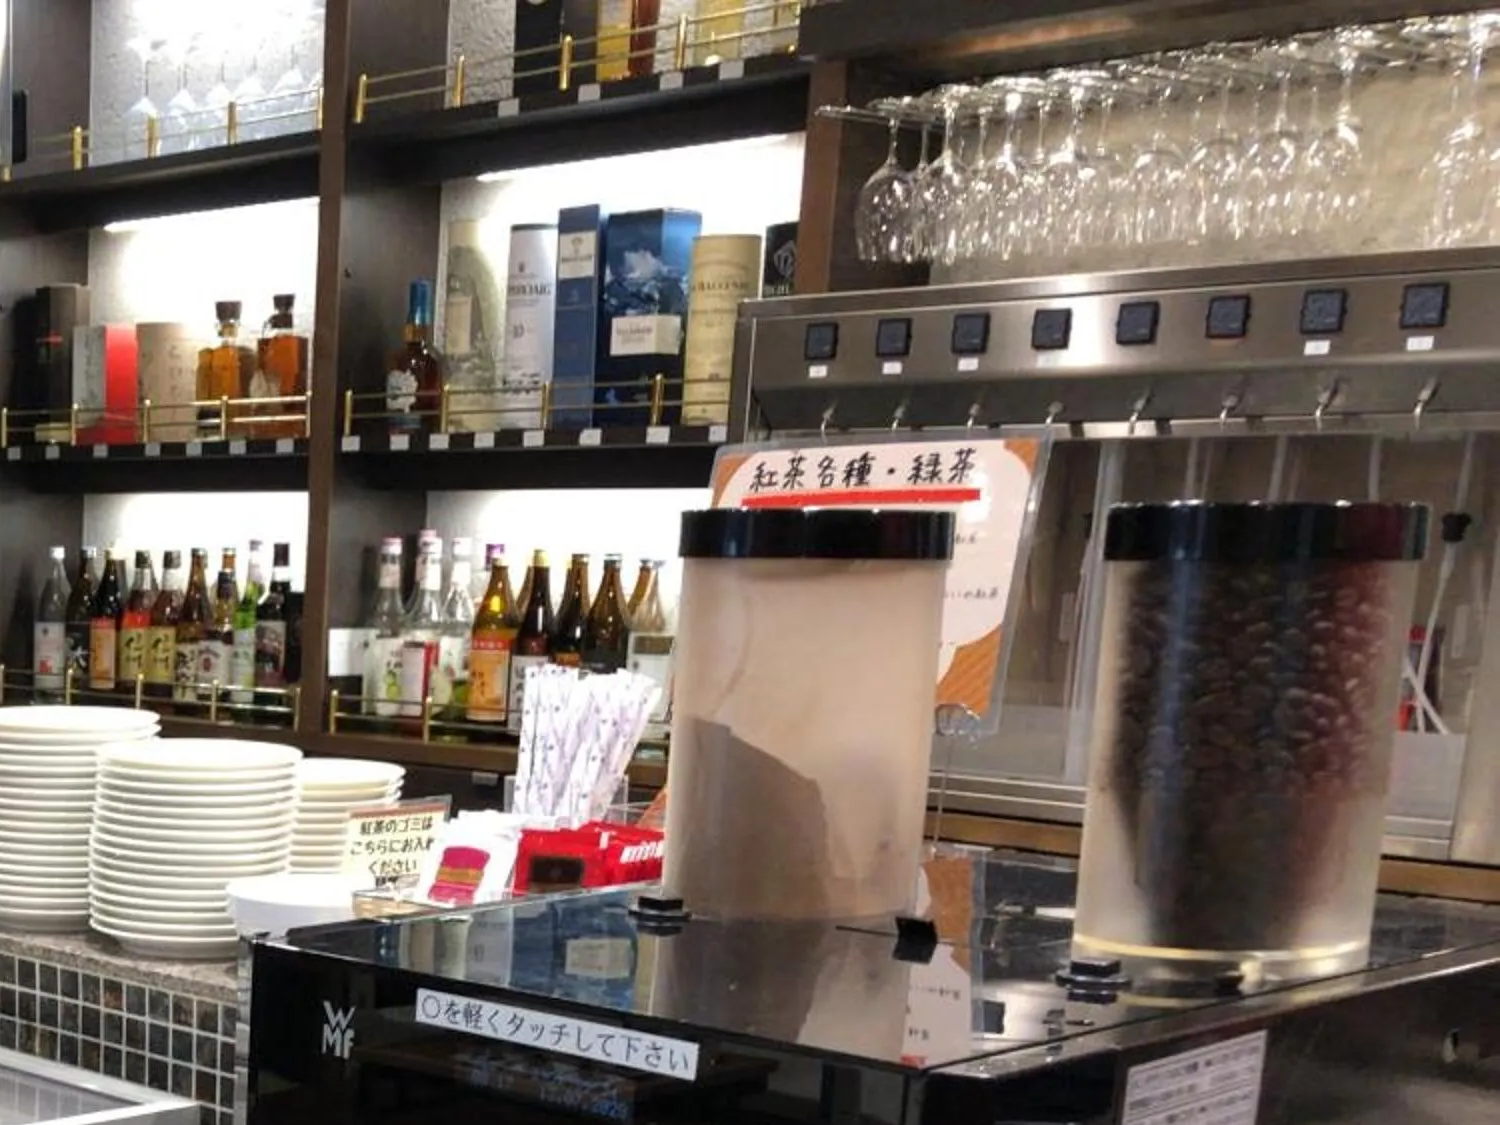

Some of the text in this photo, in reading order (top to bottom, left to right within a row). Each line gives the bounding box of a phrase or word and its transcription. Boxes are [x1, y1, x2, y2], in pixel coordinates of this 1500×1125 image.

[750, 448, 976, 491] 紅茶各種・緑茶
[360, 815, 433, 836] 紅茶のゴミは
[368, 858, 417, 875] ください
